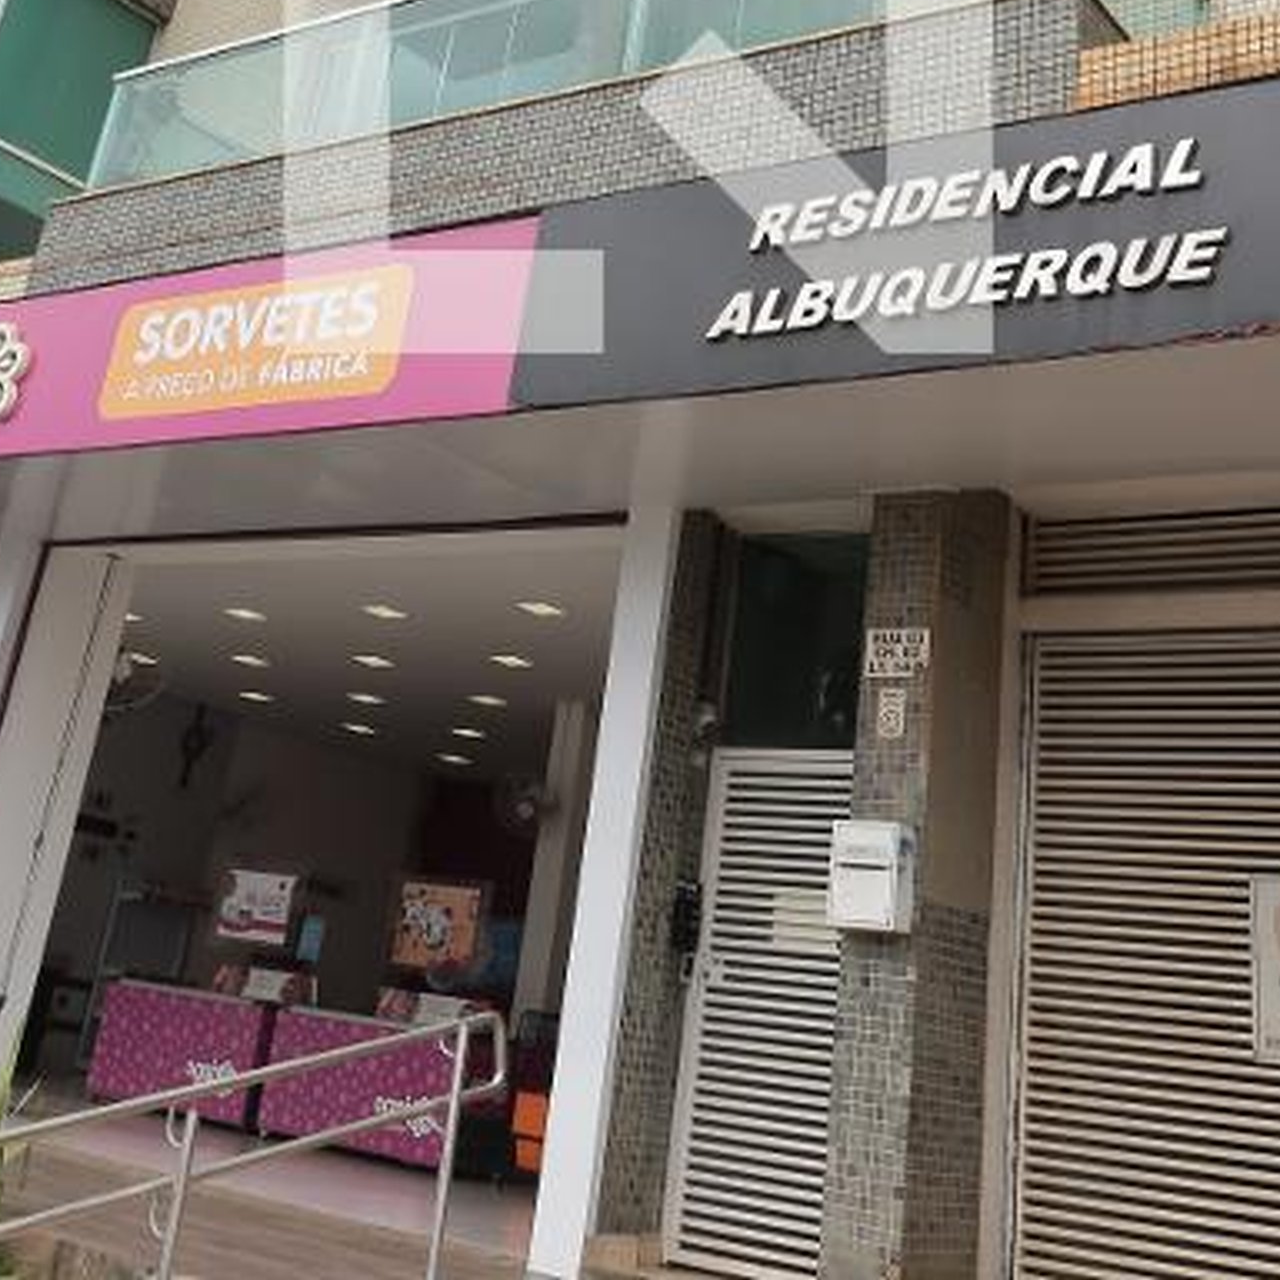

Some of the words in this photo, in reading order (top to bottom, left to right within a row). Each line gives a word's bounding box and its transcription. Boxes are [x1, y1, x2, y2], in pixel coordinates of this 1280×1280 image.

[747, 136, 1206, 252] RESIDENCIAL
[136, 284, 377, 363] SORVETES
[705, 227, 1227, 341] ALBUQUERQUE
